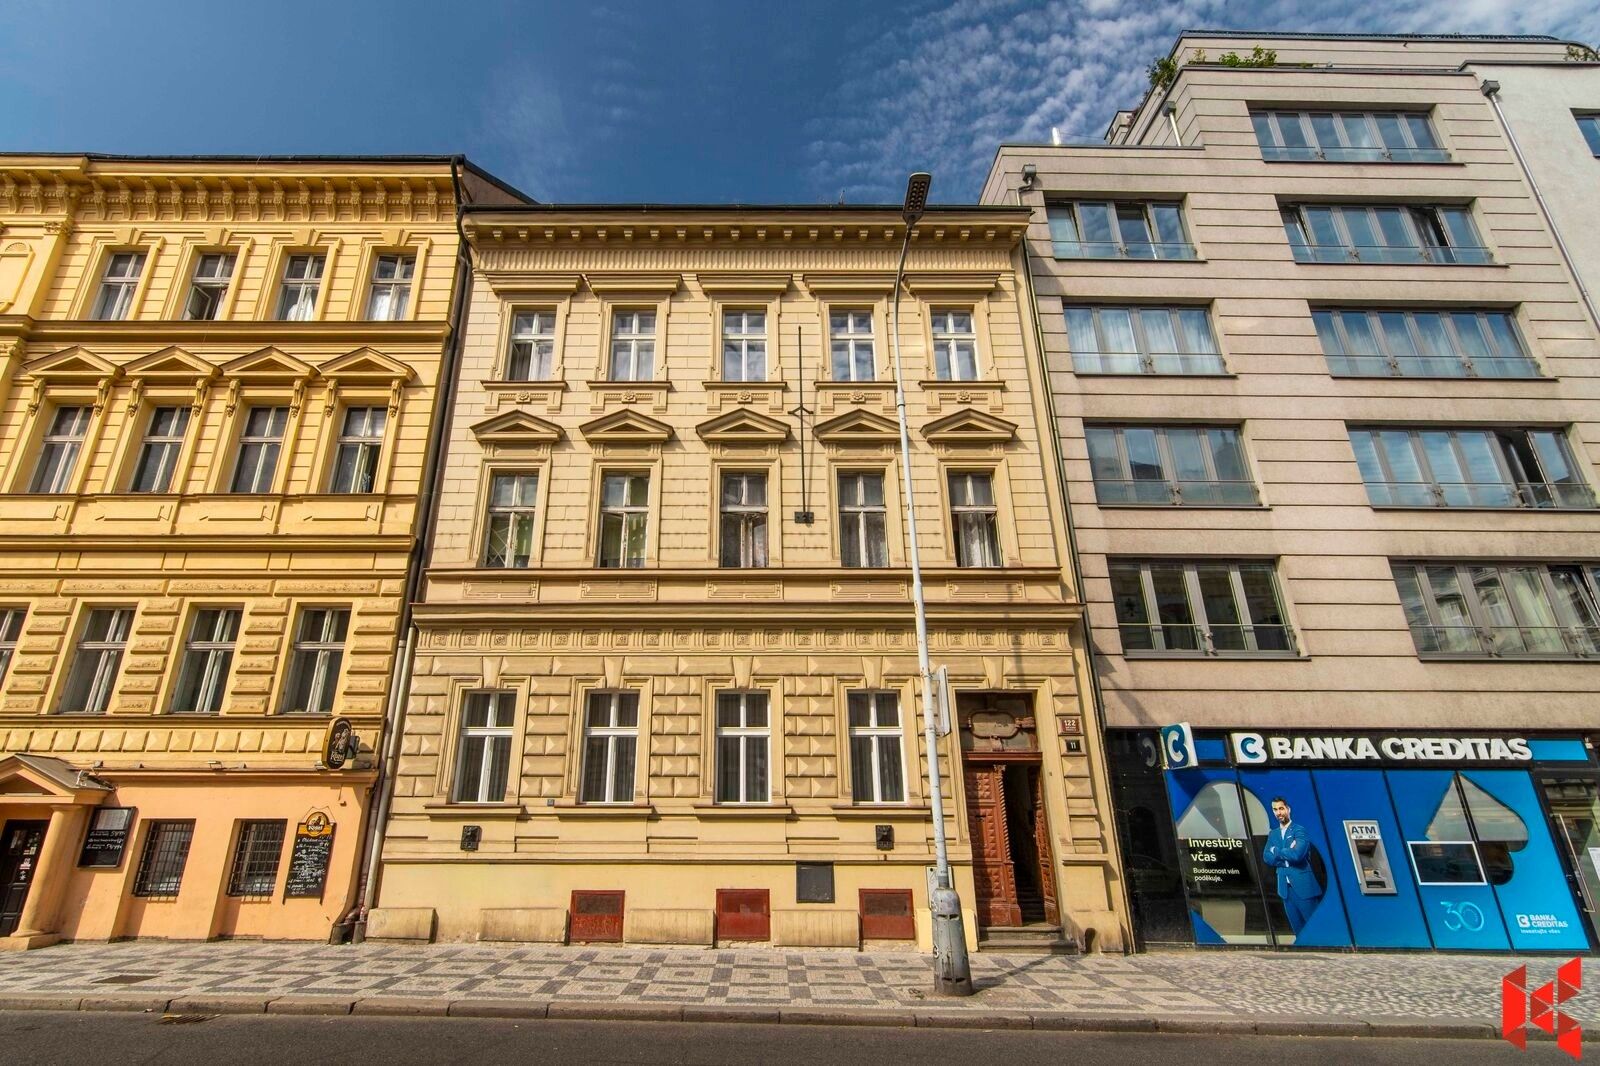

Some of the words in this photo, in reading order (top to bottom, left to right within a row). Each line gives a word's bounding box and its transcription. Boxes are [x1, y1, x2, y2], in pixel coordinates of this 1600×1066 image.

[1269, 737, 1380, 760] BANKA
[1381, 737, 1533, 761] CREDITAS
[1351, 825, 1377, 834] ATM
[1188, 837, 1243, 850] Investujte
[1190, 851, 1217, 862] včas
[1440, 901, 1485, 931] 30
[1531, 920, 1569, 928] CREDITAS
